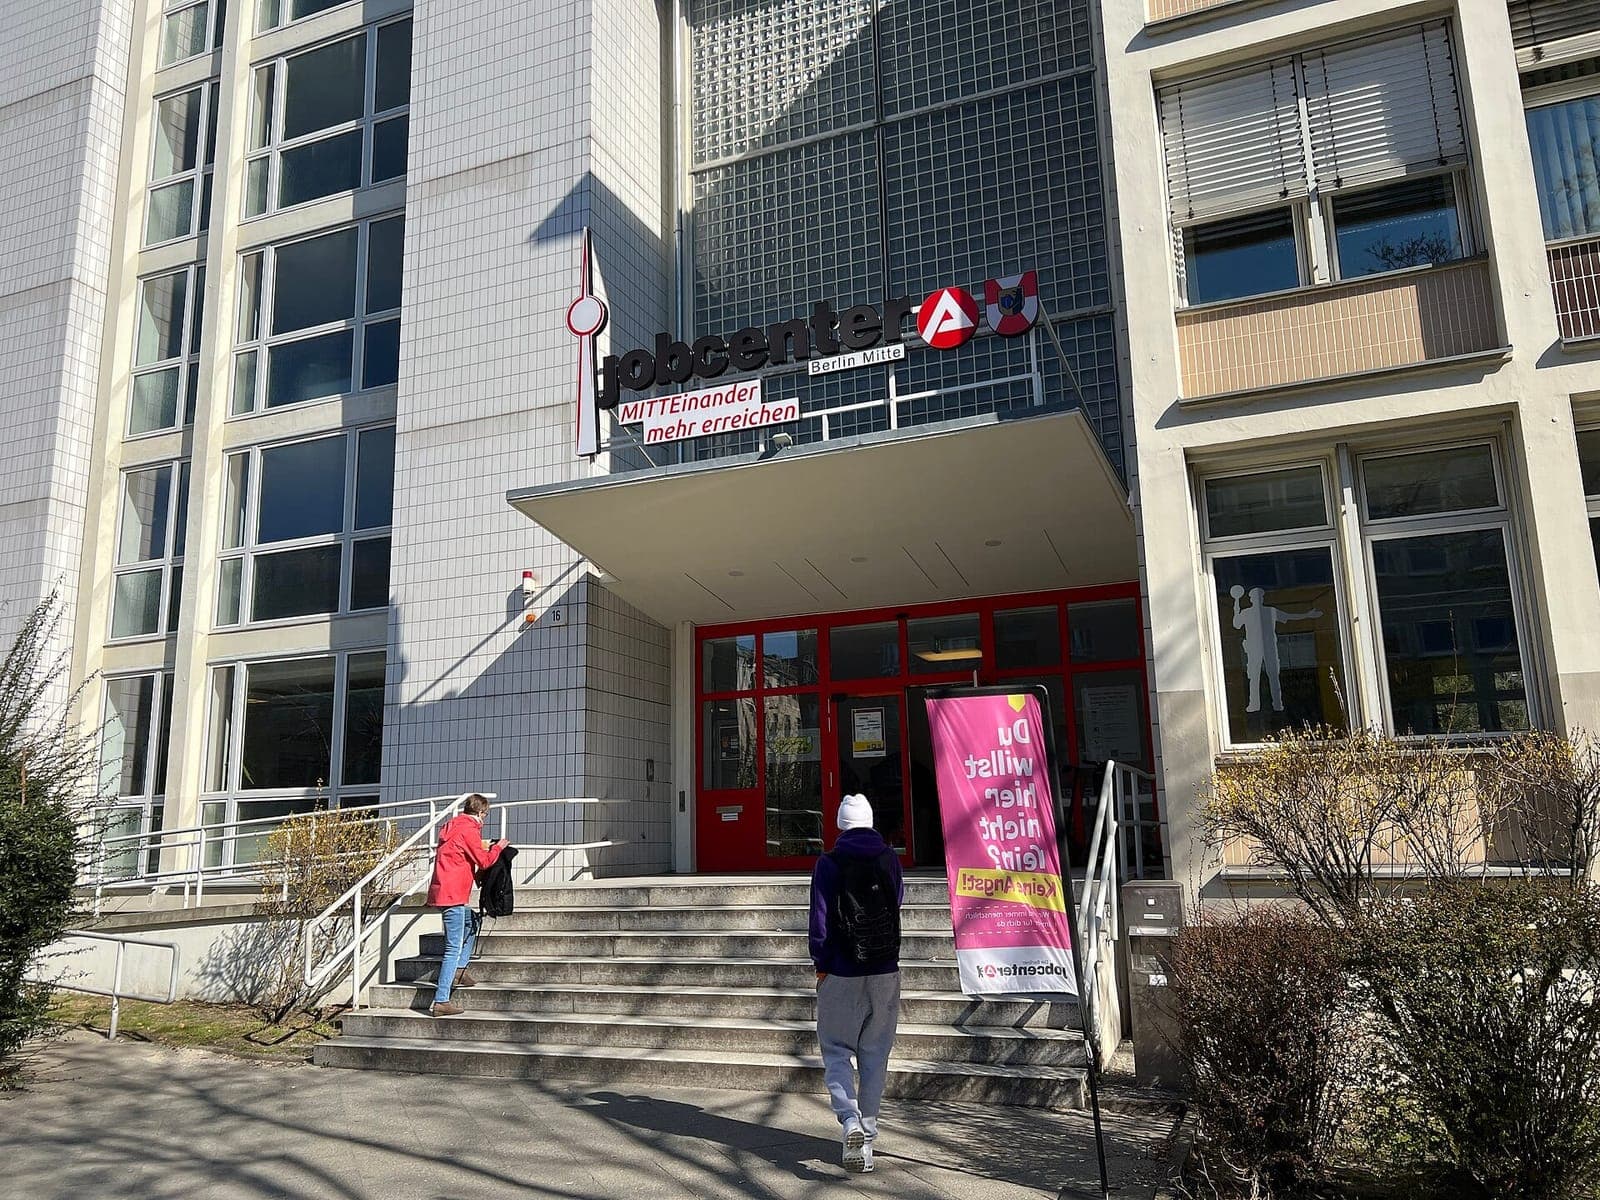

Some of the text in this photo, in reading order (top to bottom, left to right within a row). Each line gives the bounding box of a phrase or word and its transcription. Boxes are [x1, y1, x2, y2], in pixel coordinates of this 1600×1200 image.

[598, 295, 912, 410] jobcenter
[810, 346, 902, 374] Berlin Mitte
[620, 383, 759, 423] MITTEinander
[646, 404, 796, 443] mehr erreichen
[552, 610, 561, 622] 16
